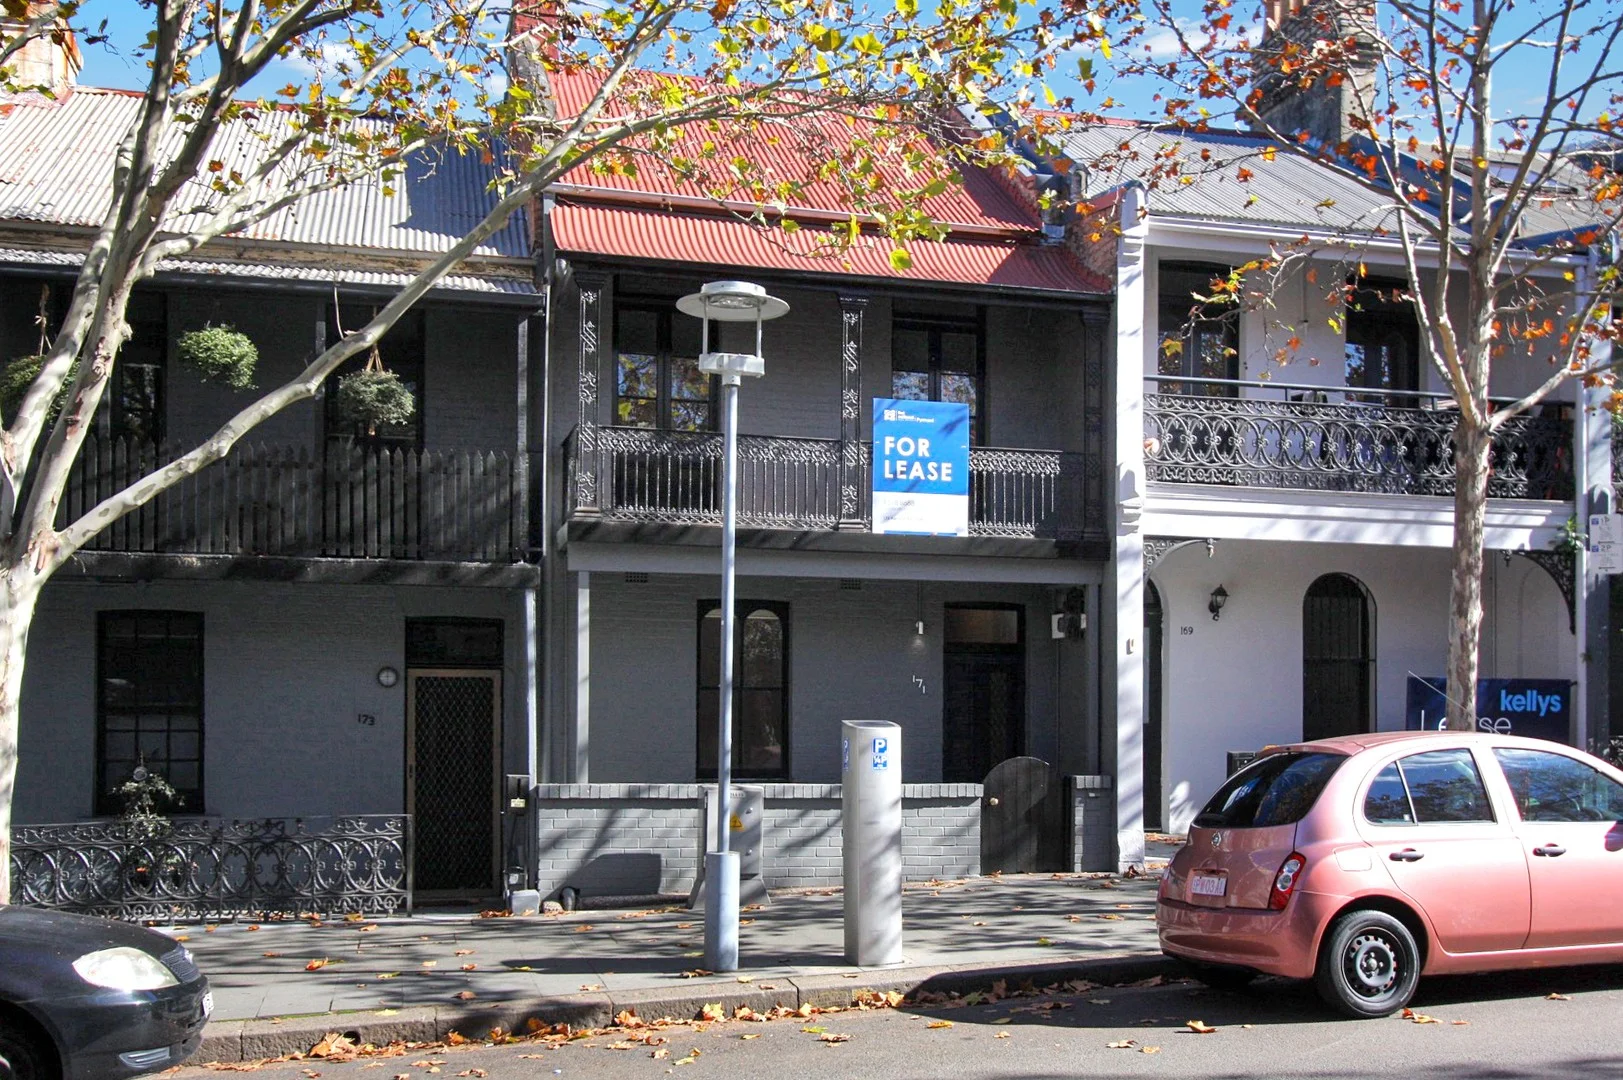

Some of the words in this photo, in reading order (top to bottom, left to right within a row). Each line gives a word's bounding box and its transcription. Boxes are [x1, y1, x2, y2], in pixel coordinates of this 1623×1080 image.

[884, 436, 930, 457] FOR
[884, 460, 952, 482] LEASE
[1180, 626, 1194, 635] 169
[912, 675, 926, 694] 171
[1500, 689, 1562, 717] kellys
[358, 713, 376, 726] 173
[875, 739, 886, 753] P
